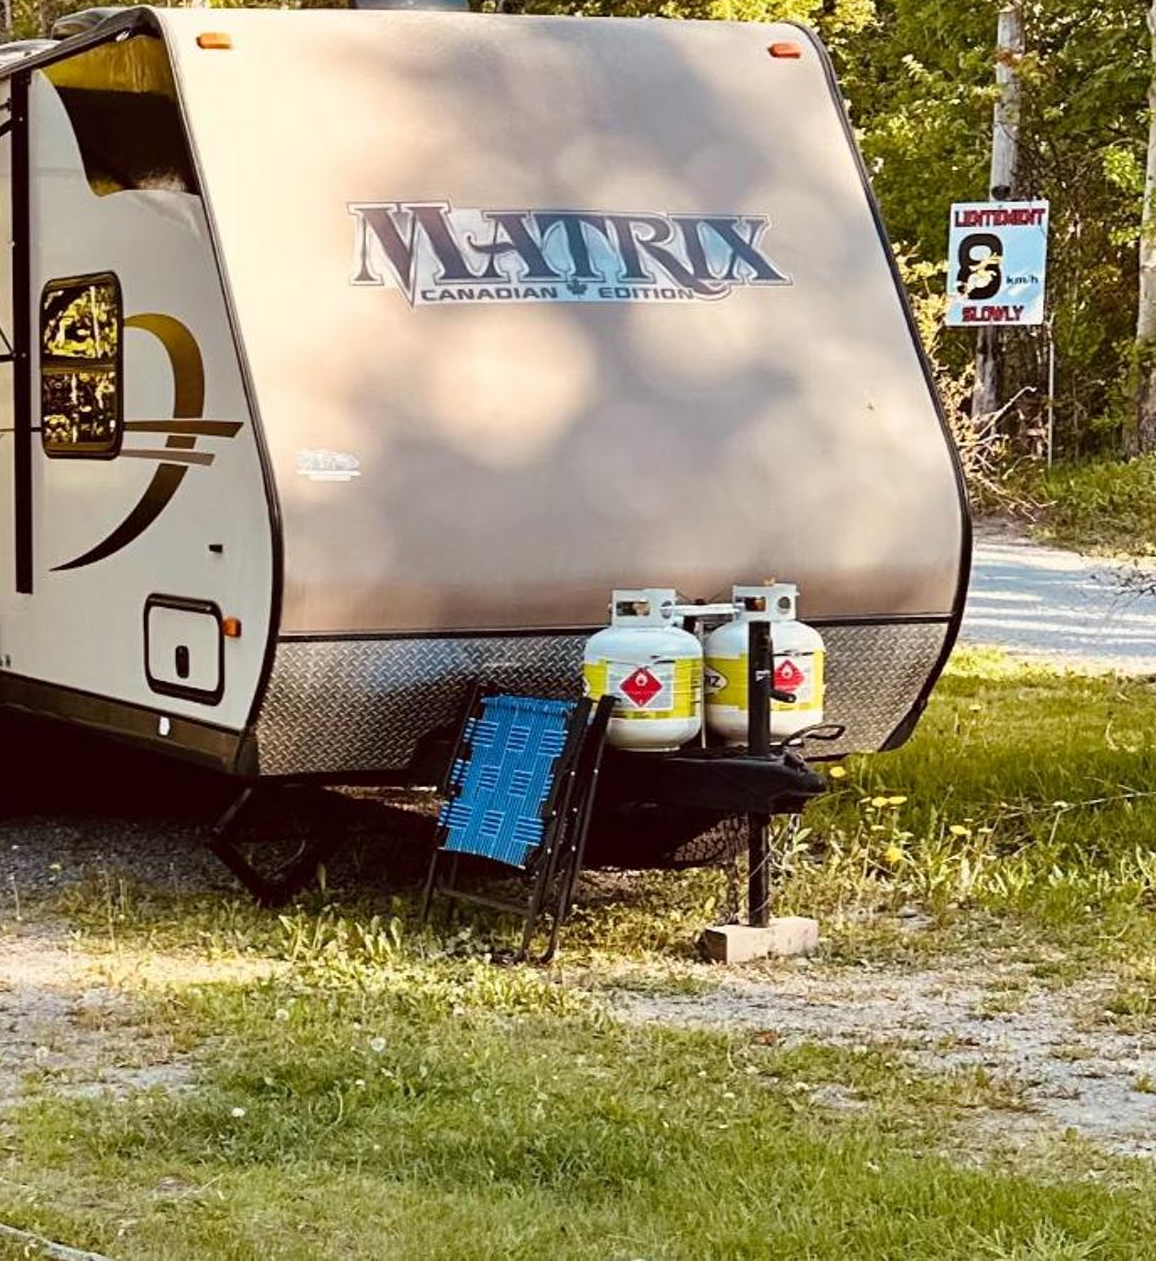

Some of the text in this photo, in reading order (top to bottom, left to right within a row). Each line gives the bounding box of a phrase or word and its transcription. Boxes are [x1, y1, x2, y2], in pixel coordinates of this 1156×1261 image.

[955, 208, 1046, 228] LENTEMENT
[349, 203, 793, 306] MATRIX
[957, 233, 1003, 300] 8
[420, 285, 695, 302] CANADIAN EDITION
[962, 305, 1024, 322] SLOWLY
